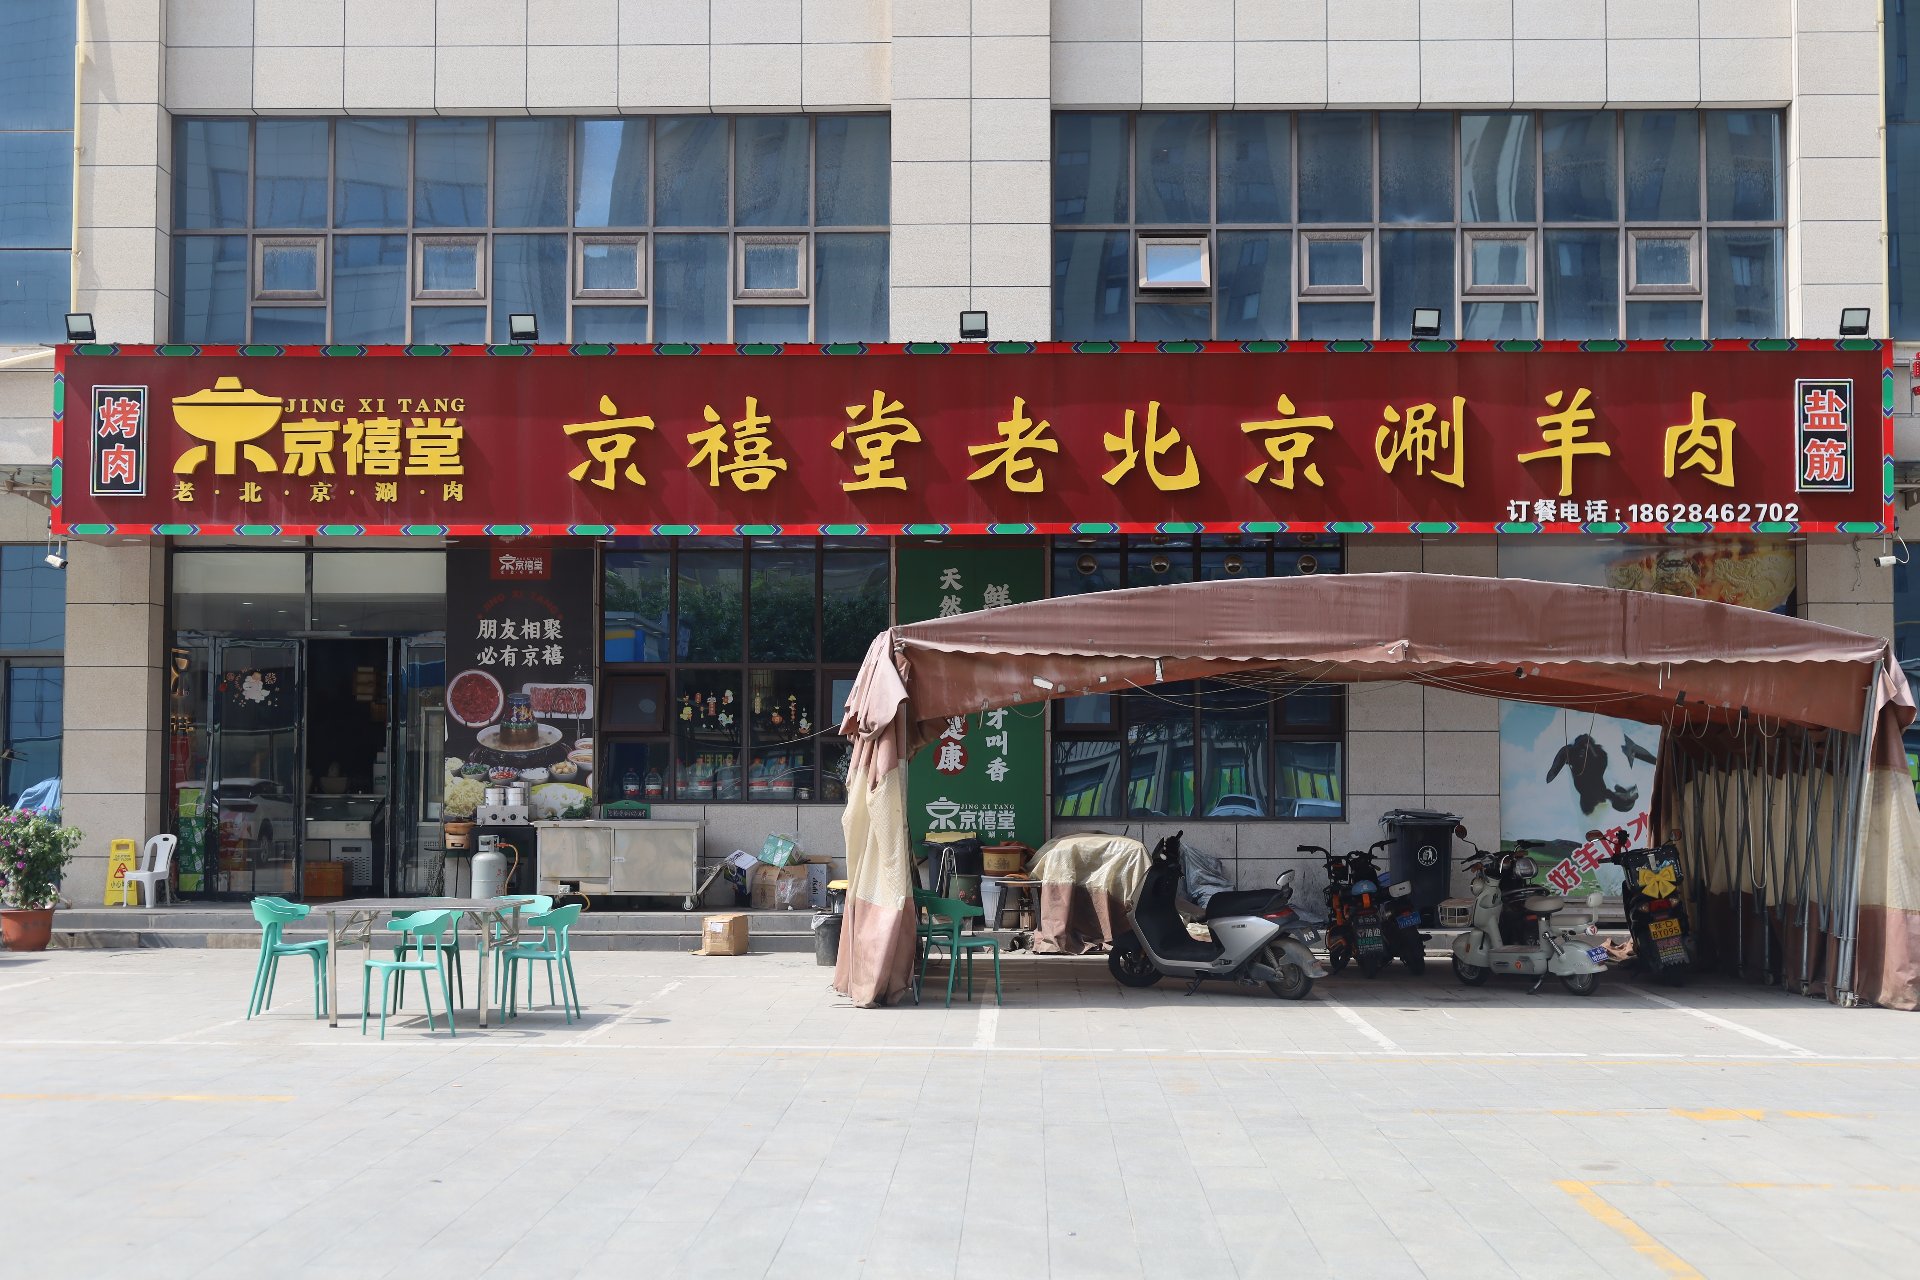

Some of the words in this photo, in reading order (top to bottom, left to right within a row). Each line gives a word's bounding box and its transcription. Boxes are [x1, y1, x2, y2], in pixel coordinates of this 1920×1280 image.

[285, 398, 344, 413] JING
[358, 398, 385, 413] XI
[398, 398, 465, 413] TANG
[98, 397, 140, 485] 烤肉
[281, 416, 465, 477] 京禧堂
[563, 388, 1737, 497] 京禧堂老北京涮羊肉
[1803, 389, 1847, 482] 盐筋
[476, 617, 564, 641] 朋友相聚
[476, 643, 565, 668] 必有京禧
[958, 810, 1016, 830] 京禧堂
